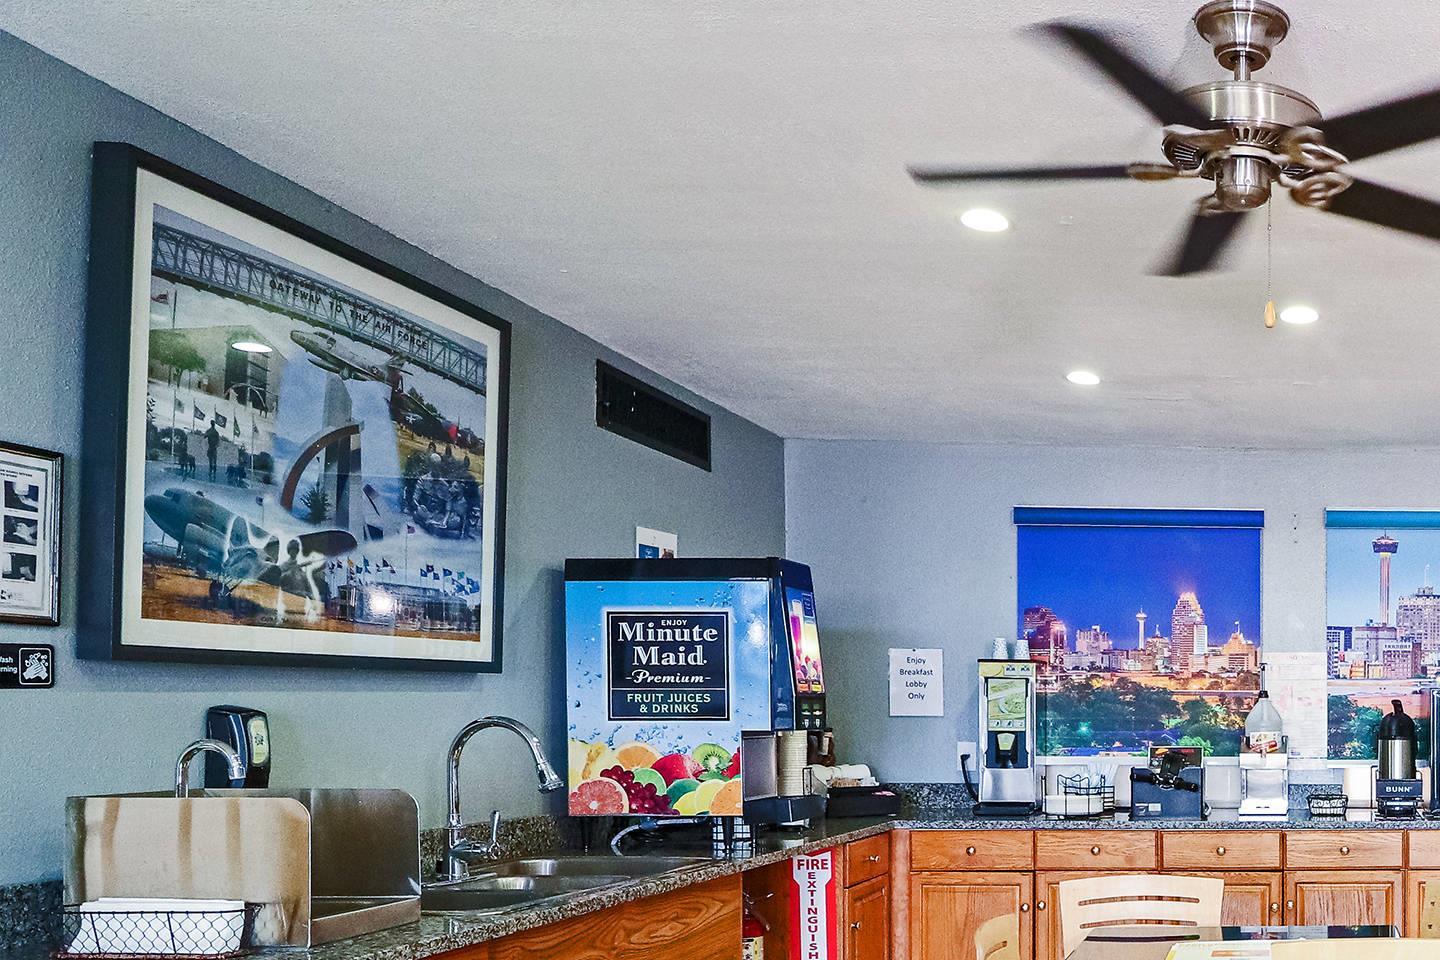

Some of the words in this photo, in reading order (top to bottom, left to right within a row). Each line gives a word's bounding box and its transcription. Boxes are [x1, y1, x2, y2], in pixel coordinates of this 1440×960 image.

[270, 280, 321, 304] GATEWAY
[329, 300, 342, 313] TO
[349, 309, 369, 323] THE
[375, 321, 391, 334] AIR
[398, 330, 430, 349] FORCE
[617, 622, 718, 642] Minute
[906, 656, 926, 664] Enjoy
[0, 665, 18, 674] rning
[899, 668, 933, 676] Breakfast
[627, 693, 664, 703] FRUIT
[667, 693, 711, 703] JUICES
[908, 692, 925, 700] Only
[639, 704, 648, 713] &
[652, 704, 699, 713] DRINKS
[797, 858, 829, 871] FIRE
